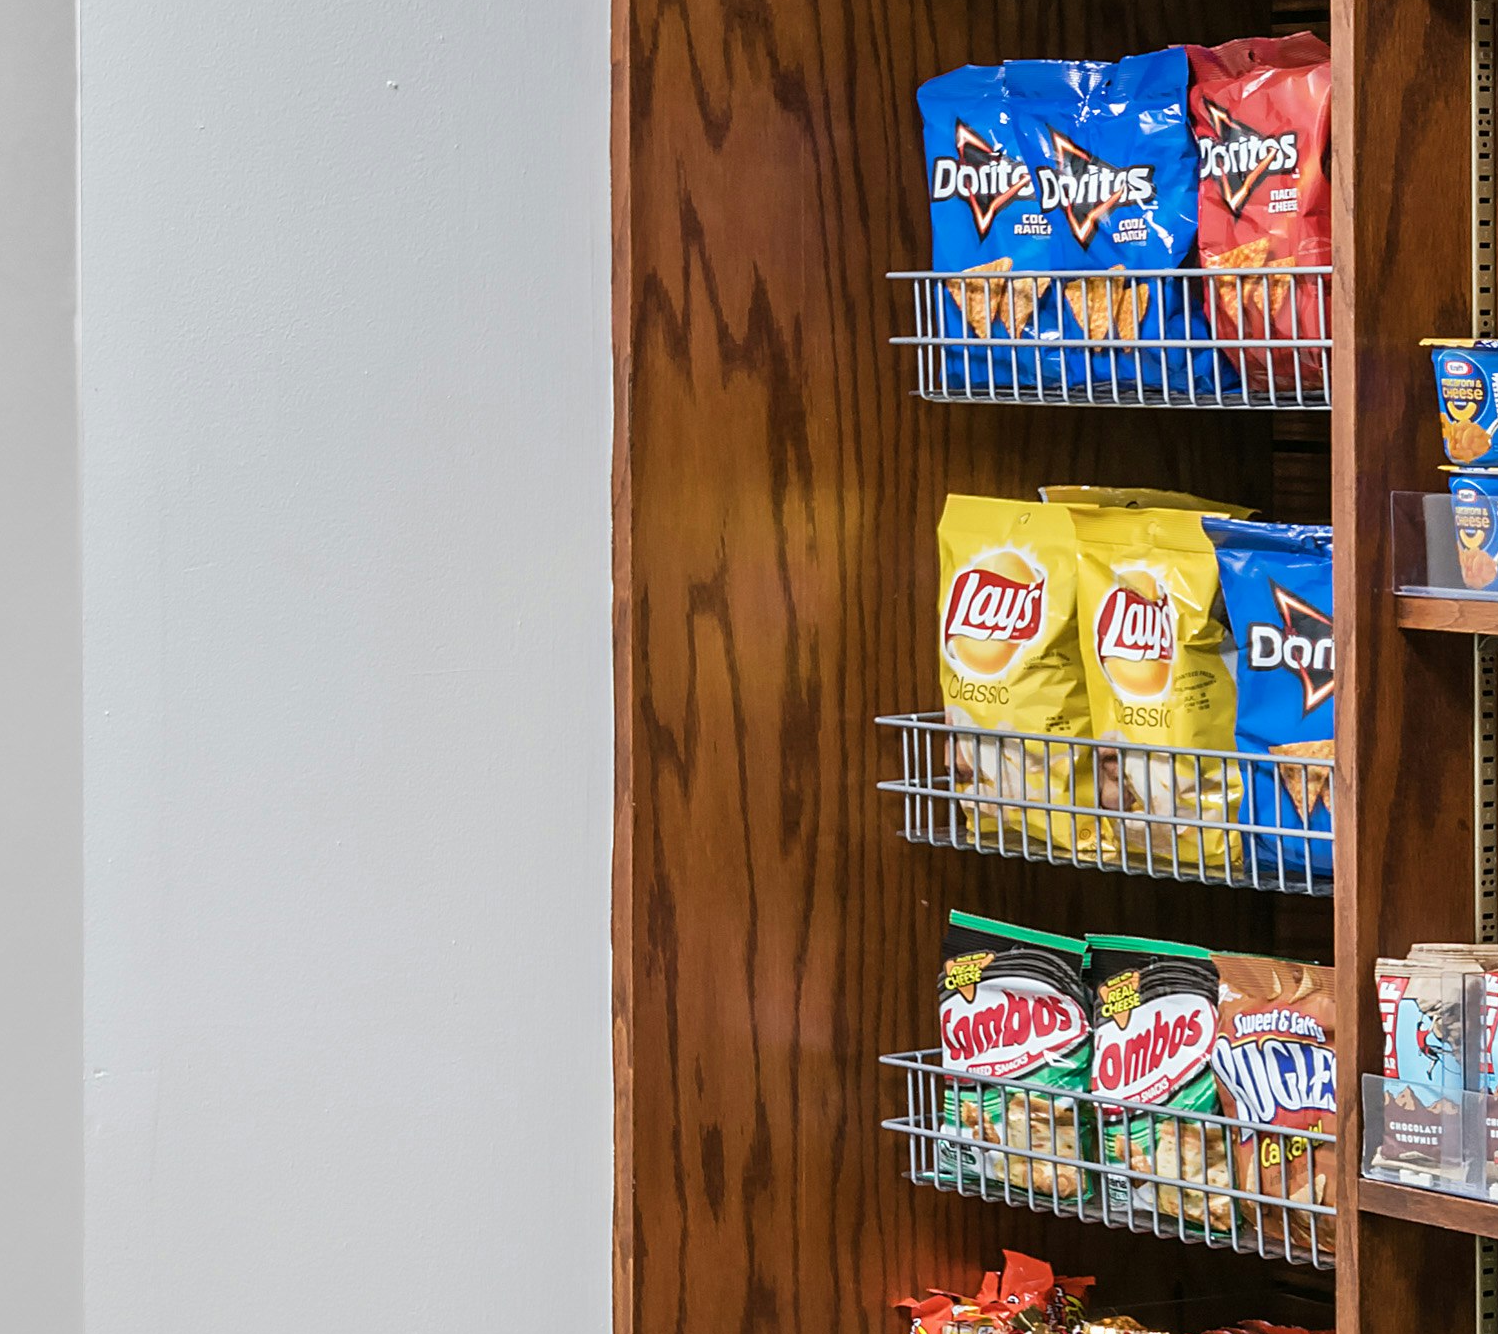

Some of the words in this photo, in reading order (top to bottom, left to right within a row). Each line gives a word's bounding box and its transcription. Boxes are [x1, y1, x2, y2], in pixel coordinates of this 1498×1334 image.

[1200, 133, 1297, 178] Doritos
[1040, 167, 1154, 210] Doritos
[1113, 230, 1148, 243] RANCH
[1119, 218, 1147, 231] COOL
[948, 572, 1042, 641] Lay's
[1100, 589, 1174, 660] Lay's
[948, 673, 1010, 706] Classic
[945, 970, 982, 990] CHEESE
[1107, 983, 1136, 1002] REAL
[1102, 994, 1142, 1017] CHEESE
[942, 988, 1073, 1061] Combos
